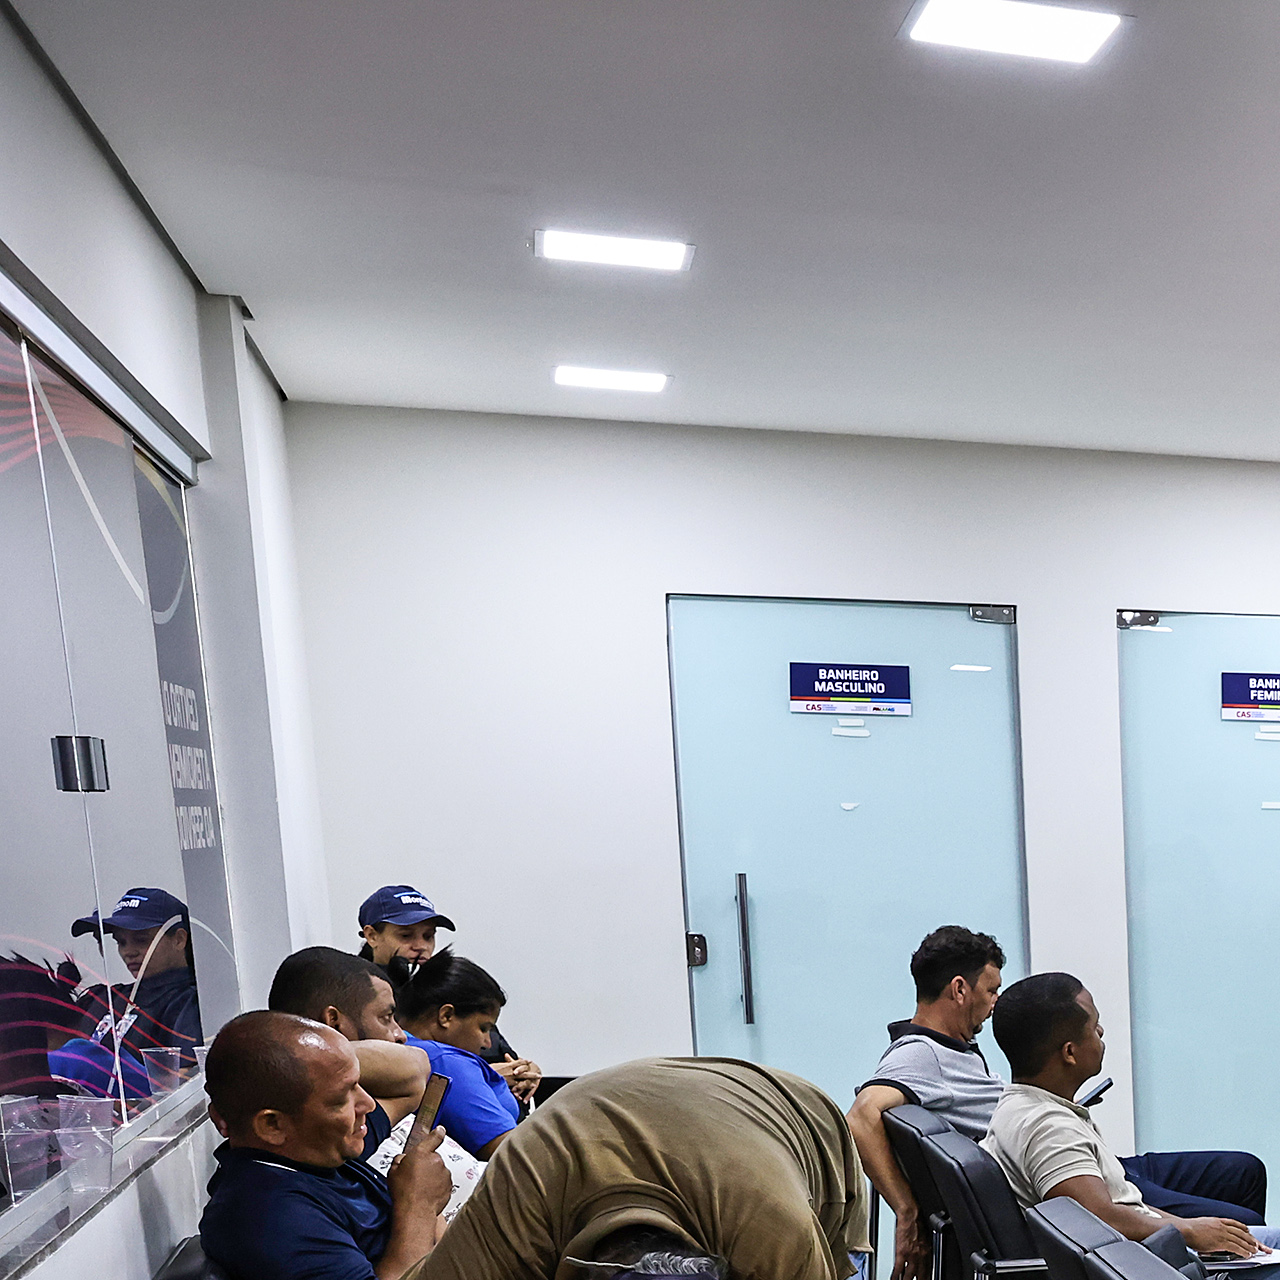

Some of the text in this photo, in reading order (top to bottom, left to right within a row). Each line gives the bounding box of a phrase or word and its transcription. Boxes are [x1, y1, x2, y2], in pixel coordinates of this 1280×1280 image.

[818, 668, 879, 681] BANHEIRO
[814, 681, 886, 693] MASCULINO
[805, 703, 822, 711] CAS
